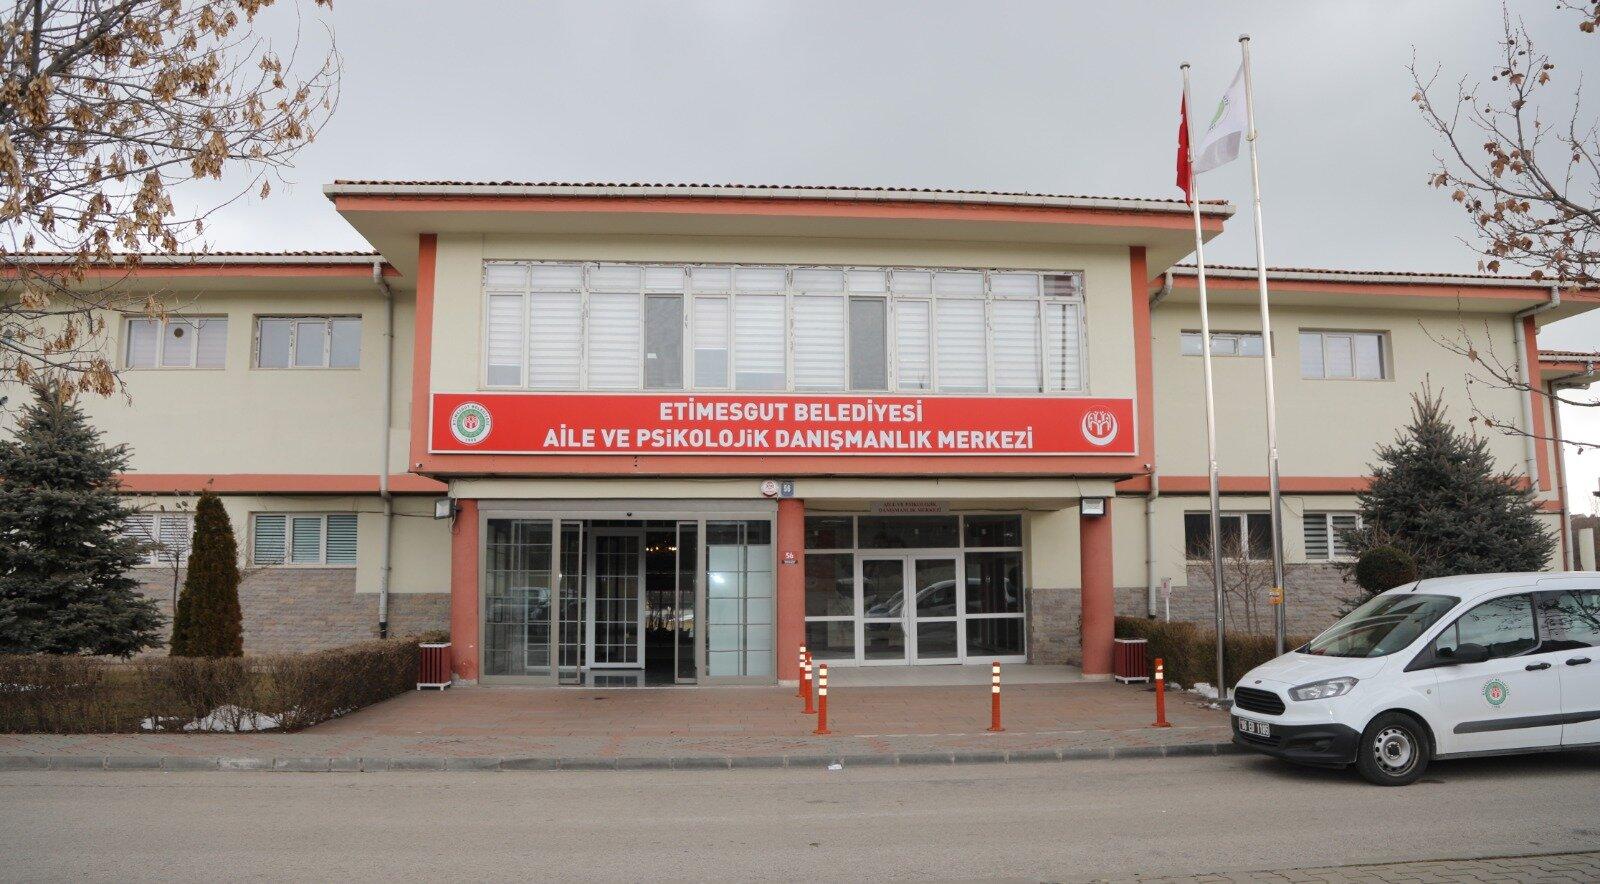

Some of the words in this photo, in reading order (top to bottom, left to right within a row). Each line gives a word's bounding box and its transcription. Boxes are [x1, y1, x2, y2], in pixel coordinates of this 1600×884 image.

[660, 397, 789, 421] ETİMESGUT
[794, 399, 924, 422] BELEDİYESİ
[543, 424, 596, 448] AİLE
[601, 429, 630, 448] VE
[775, 430, 933, 451] DANIŞMANLIK
[938, 426, 1034, 449] MERKEZİ
